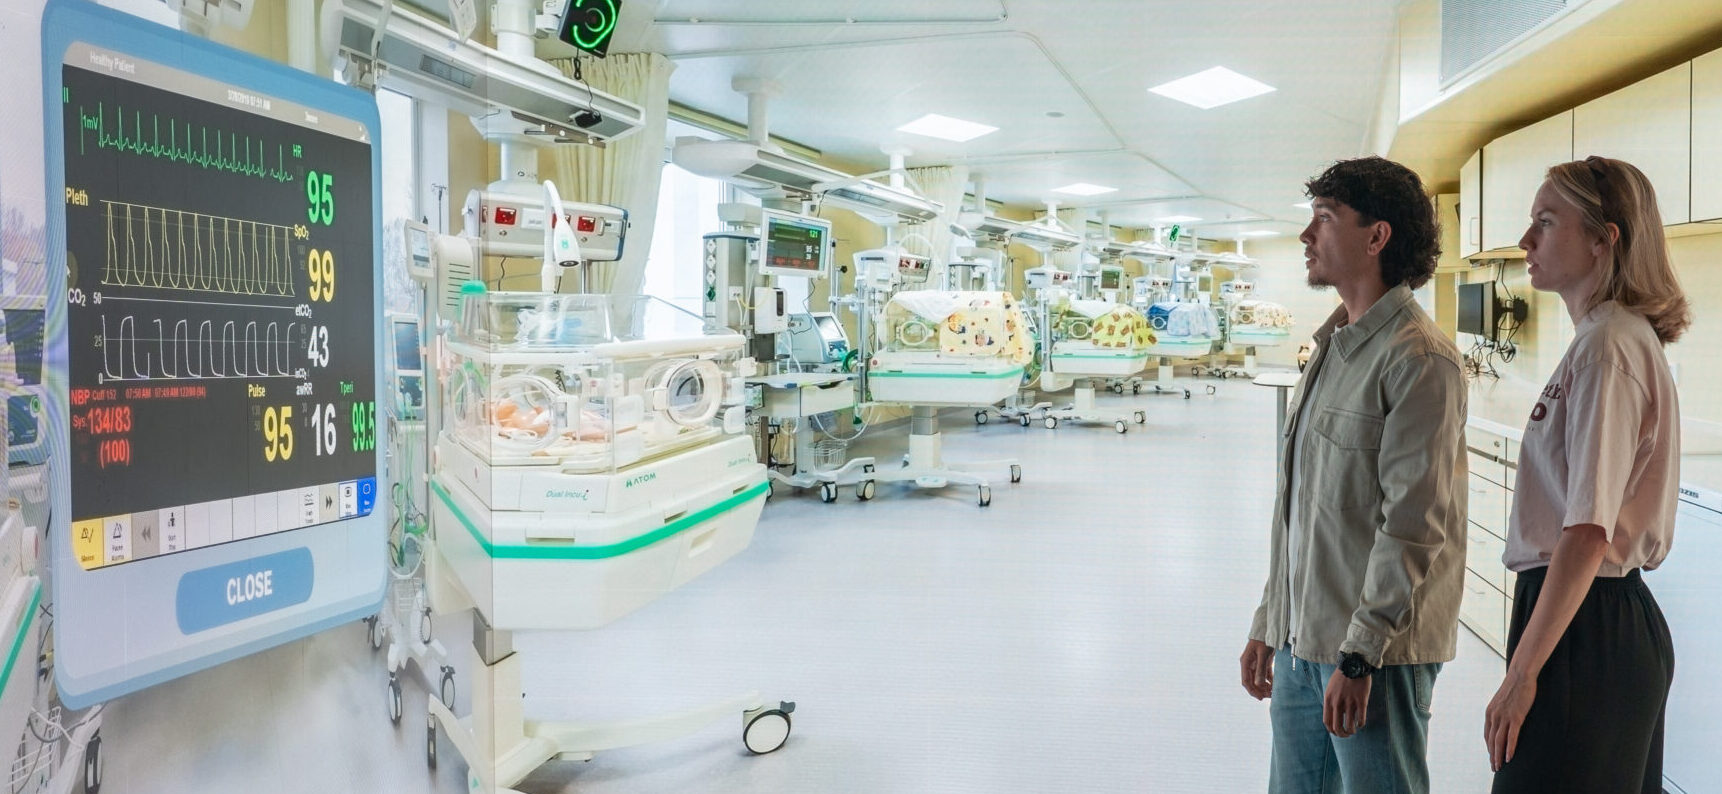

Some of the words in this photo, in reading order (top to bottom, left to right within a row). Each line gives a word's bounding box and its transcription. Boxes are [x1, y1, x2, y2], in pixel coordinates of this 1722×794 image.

[83, 115, 98, 130] 1mV
[293, 144, 302, 158] HR
[66, 187, 88, 206] Pleth
[307, 170, 334, 225] 95
[308, 248, 335, 302] 99
[93, 292, 102, 304] 50
[94, 335, 103, 347] 25
[308, 326, 329, 368] 43
[99, 372, 103, 385] 0
[71, 388, 91, 405] NBP
[92, 389, 105, 400] Cuff
[106, 389, 117, 400] 152
[248, 384, 266, 398] Pulse
[296, 382, 313, 396] awRR
[87, 406, 132, 434] 134/83
[311, 402, 337, 457] 16
[352, 401, 375, 452] 99.5
[263, 405, 294, 462] 95
[100, 438, 130, 469] (100)
[633, 472, 657, 485] ATOM
[227, 569, 273, 606] CLOSE
